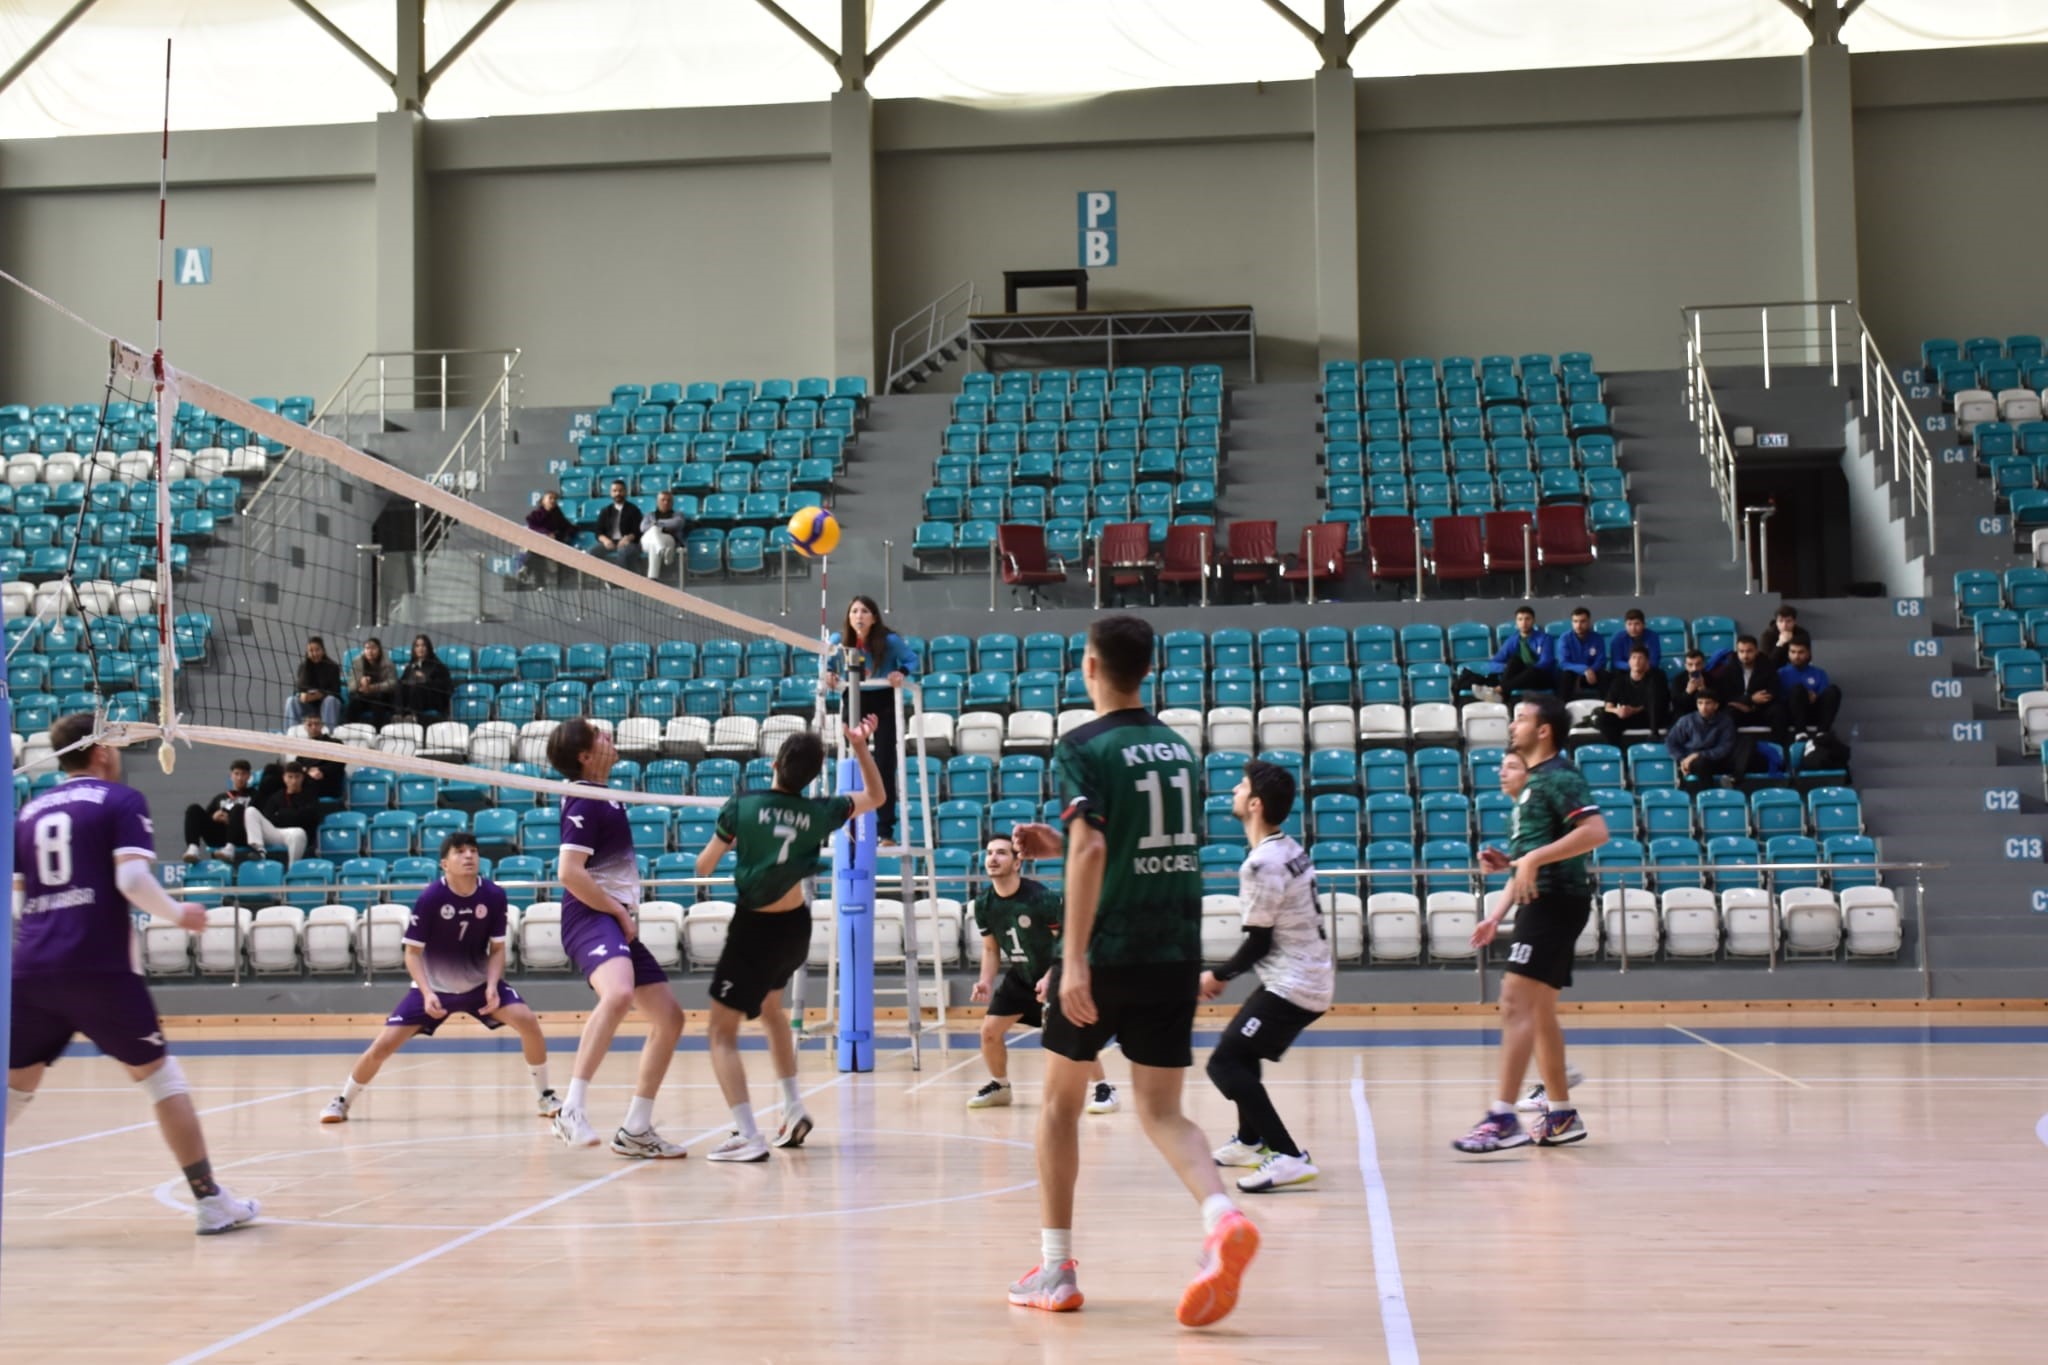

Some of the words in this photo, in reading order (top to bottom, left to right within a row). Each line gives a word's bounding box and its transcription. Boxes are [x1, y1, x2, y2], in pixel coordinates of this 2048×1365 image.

[1087, 191, 1111, 228] P
[1086, 231, 1110, 267] B
[181, 248, 205, 284] A
[1902, 370, 1921, 385] C1
[1911, 386, 1931, 399] C2
[574, 413, 592, 428] P6
[1926, 416, 1947, 431] C3
[1759, 434, 1786, 447] EXIT
[1943, 449, 1965, 464] C4
[1980, 517, 2002, 534] C6
[492, 559, 511, 573] P1
[1896, 600, 1920, 616] C8
[1914, 640, 1938, 657] C9
[1931, 680, 1962, 698] C10
[1952, 723, 1983, 741] C11
[1135, 767, 1197, 849] 11
[1985, 789, 2020, 810] C12
[758, 807, 811, 831] KYGM
[34, 811, 73, 887] 8
[773, 824, 797, 864] 7
[2005, 838, 2043, 859] C13
[163, 864, 187, 883] B5
[459, 921, 469, 941] 7
[1006, 926, 1025, 954] 1
[1508, 941, 1534, 965] 10
